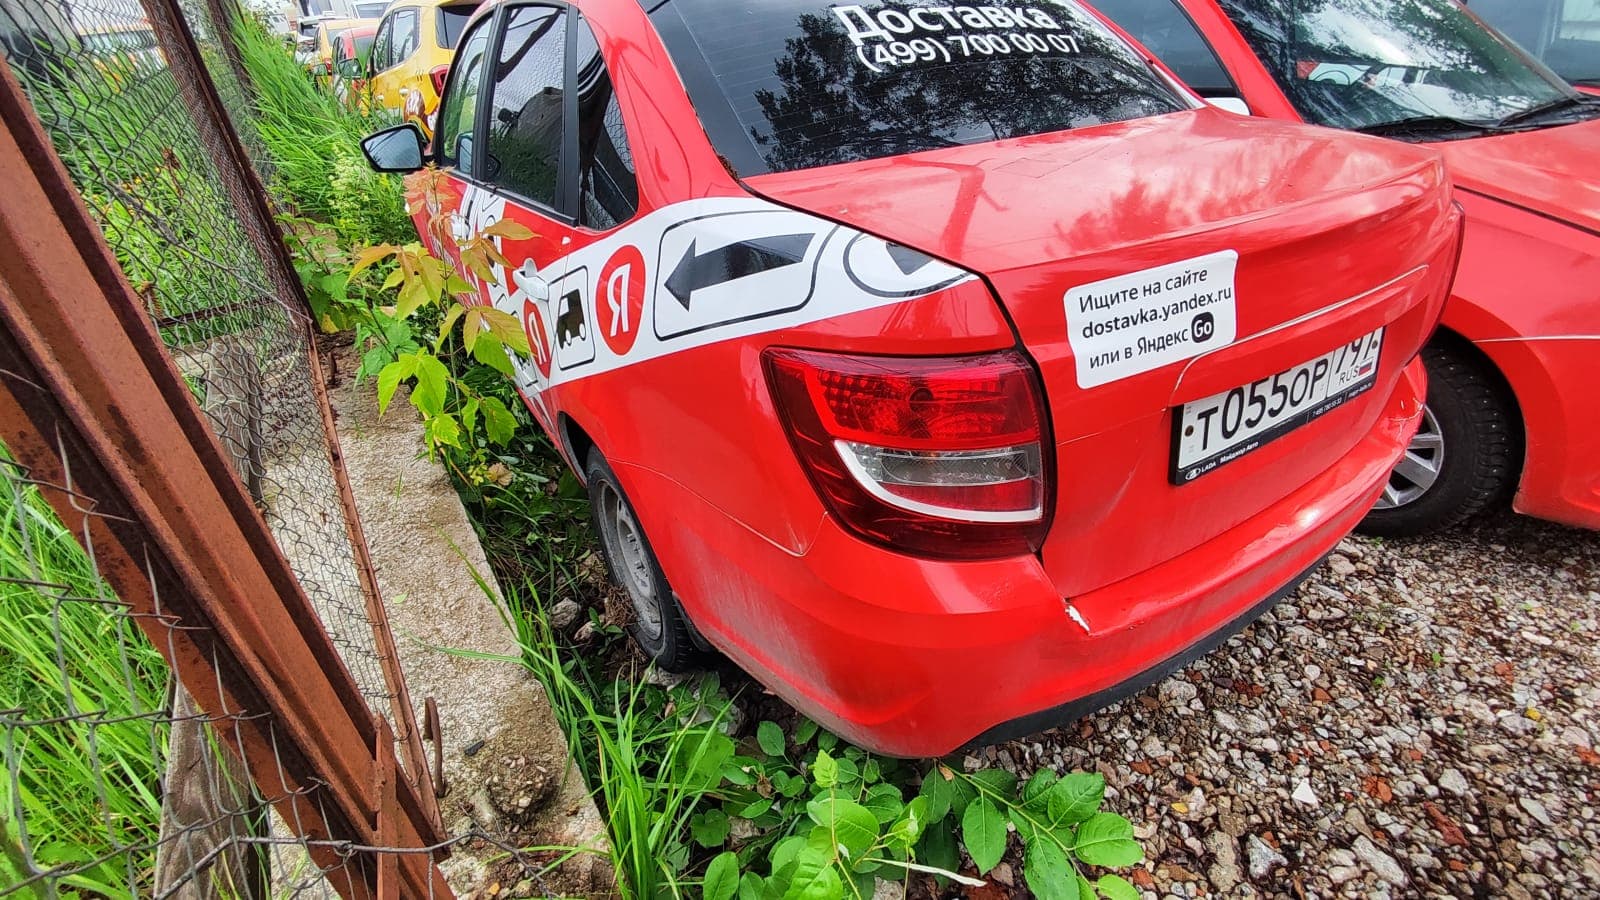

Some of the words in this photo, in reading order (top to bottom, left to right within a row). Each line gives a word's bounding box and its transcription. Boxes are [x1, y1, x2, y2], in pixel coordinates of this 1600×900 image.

[832, 6, 1061, 46] Доставка
[857, 37, 951, 72] (499)
[947, 34, 1010, 56] 700
[1009, 33, 1050, 53] 00
[1049, 34, 1080, 53] 07
[1079, 287, 1139, 313] Ищите
[1142, 281, 1162, 298] на
[1165, 268, 1208, 291] сайте
[1082, 286, 1232, 339] dostavka.yandex.ru
[1089, 350, 1120, 369] или
[1124, 346, 1133, 360] в
[1137, 328, 1189, 356] Яндекс
[1193, 319, 1213, 339] Go
[1339, 364, 1359, 385] RUS
[1201, 461, 1217, 473] LADA
